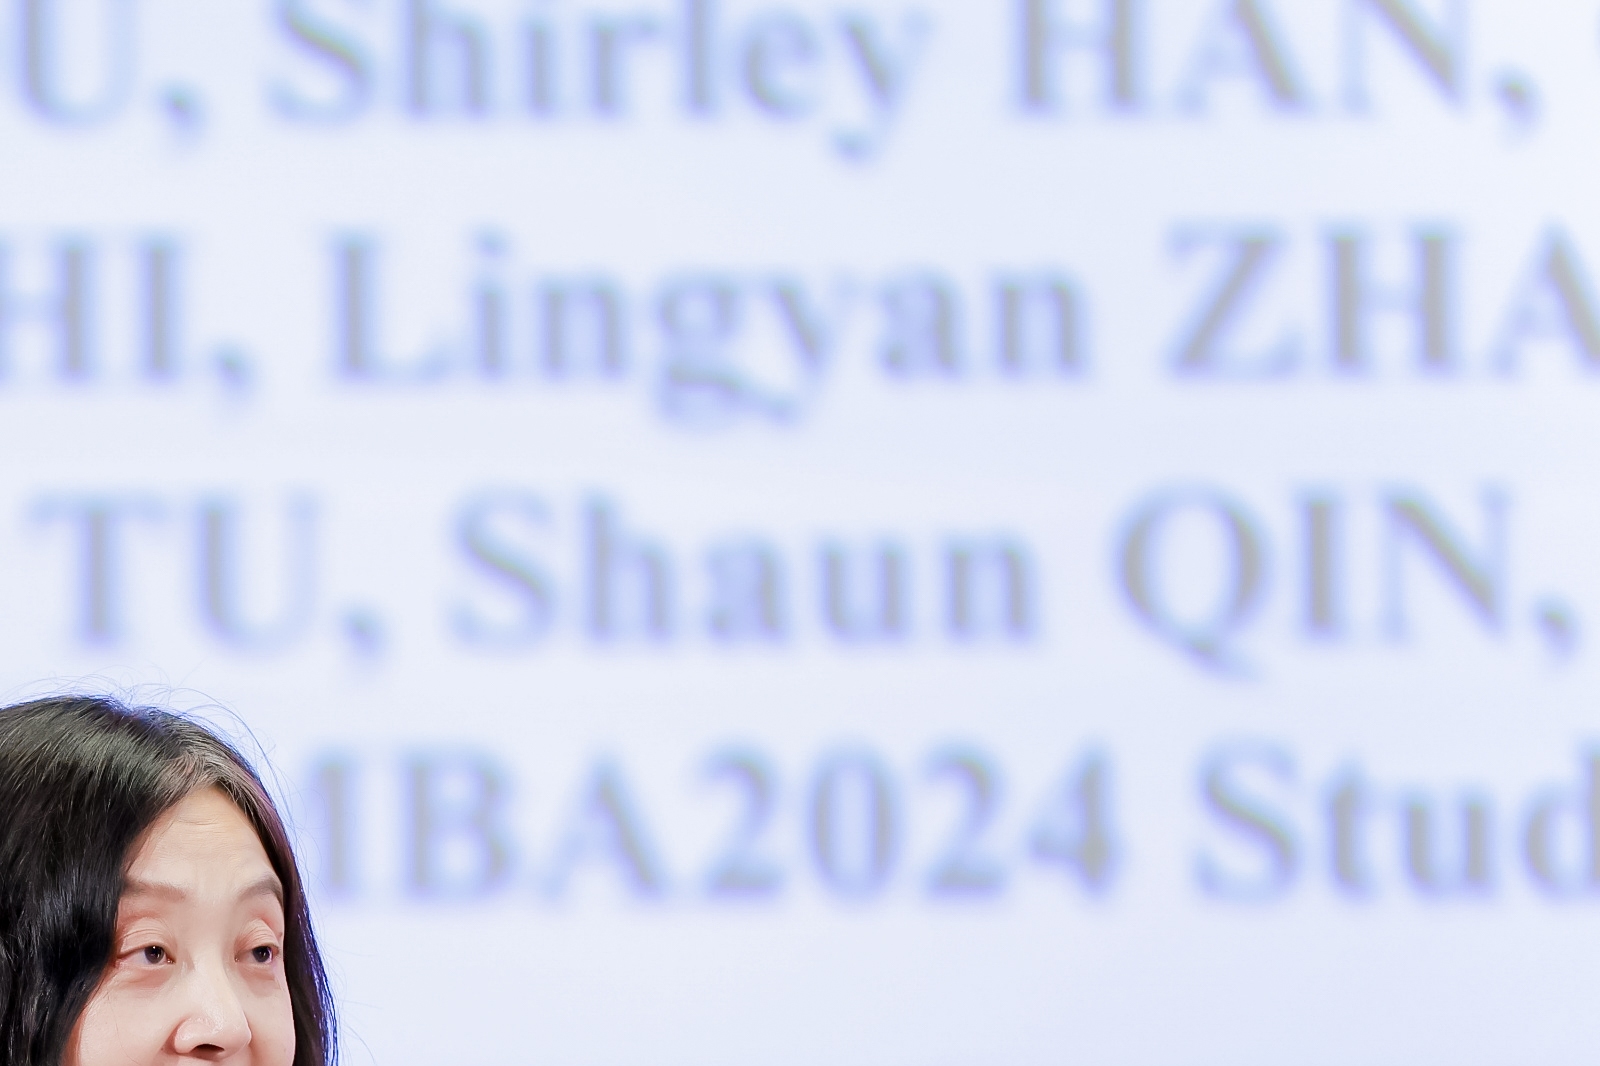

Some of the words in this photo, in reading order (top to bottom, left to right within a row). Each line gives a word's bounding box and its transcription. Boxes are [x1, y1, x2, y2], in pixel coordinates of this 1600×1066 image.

[267, 0, 934, 166] Shirley
[1006, 0, 1542, 140] HAN,
[328, 228, 1094, 430] Lingyan
[26, 490, 388, 670] TU,
[450, 488, 1044, 650] Shaun
[1108, 482, 1580, 684] QIN,
[305, 738, 1128, 904] BA2024
